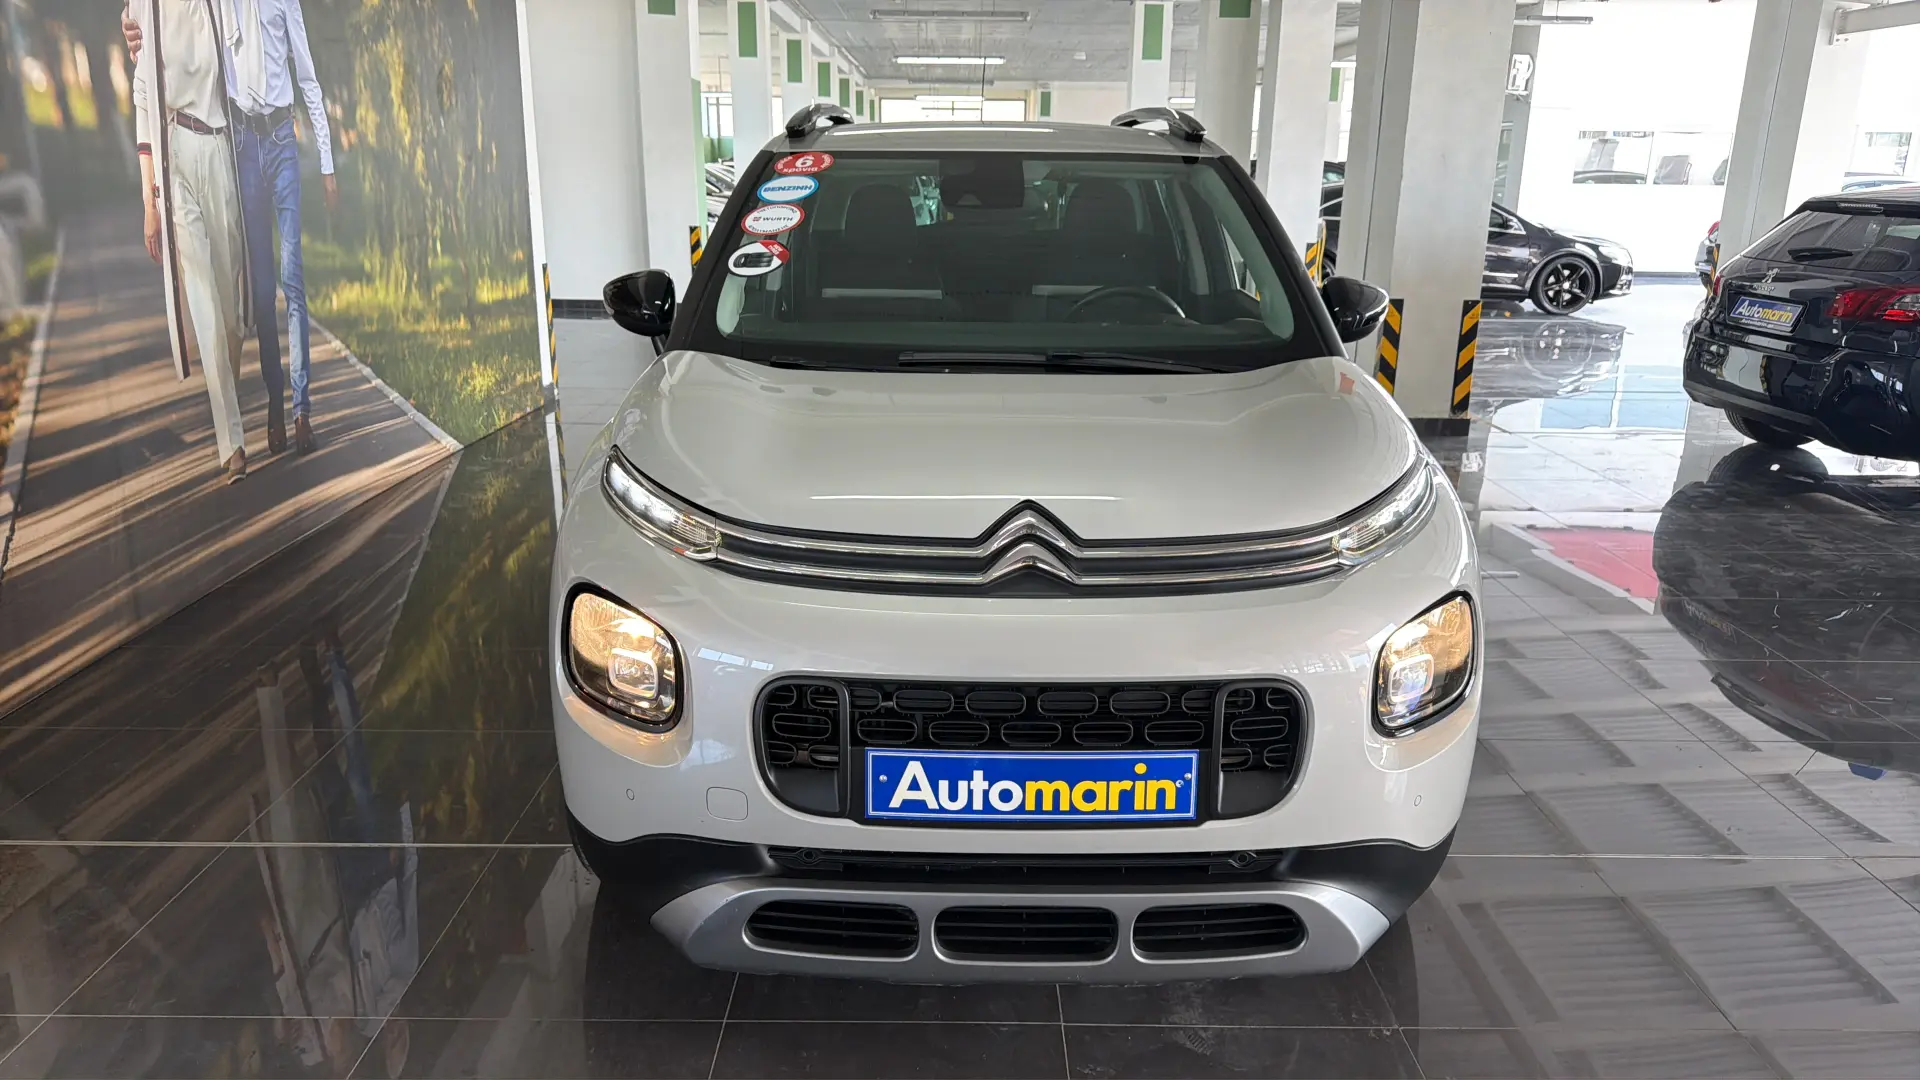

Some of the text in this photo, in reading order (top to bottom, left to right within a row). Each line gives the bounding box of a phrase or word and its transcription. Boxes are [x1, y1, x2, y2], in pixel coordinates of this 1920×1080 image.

[795, 156, 815, 168] 6
[1735, 300, 1793, 323] Automarin
[889, 760, 1178, 812] Automarin
